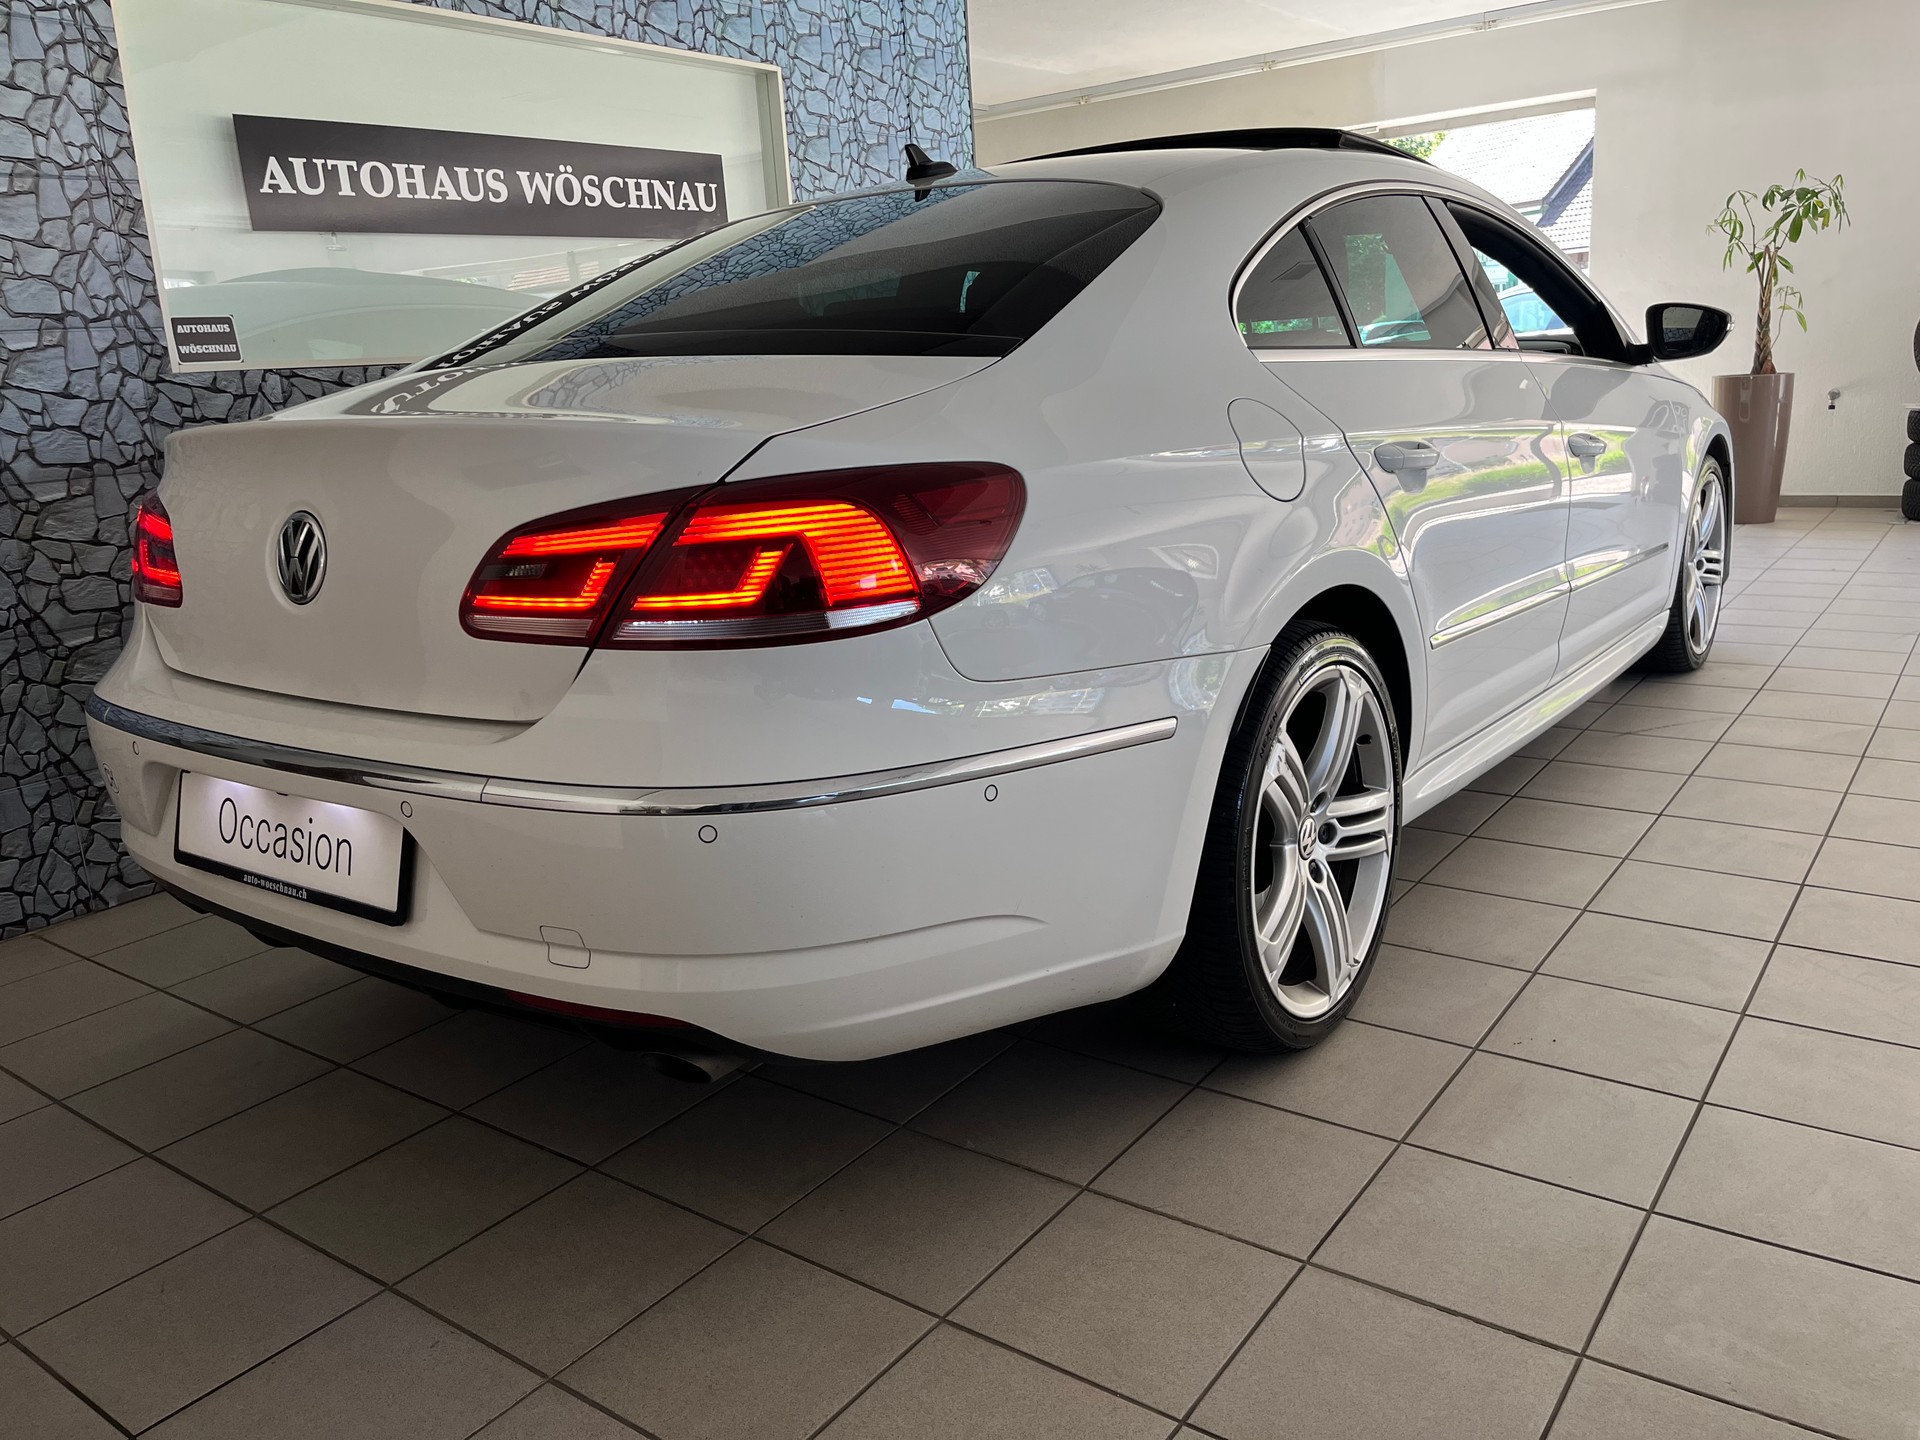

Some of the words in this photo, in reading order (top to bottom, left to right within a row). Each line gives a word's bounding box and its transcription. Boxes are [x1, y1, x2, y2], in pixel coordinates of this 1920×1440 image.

[259, 155, 509, 204] AUTOHAUS
[516, 164, 718, 213] WÖSCHNAU
[177, 324, 231, 334] AUTOHAUS
[178, 343, 237, 354] WÖSCHNAU
[219, 797, 353, 876] Occasion
[243, 874, 307, 899] auto-woeschnau.ch
